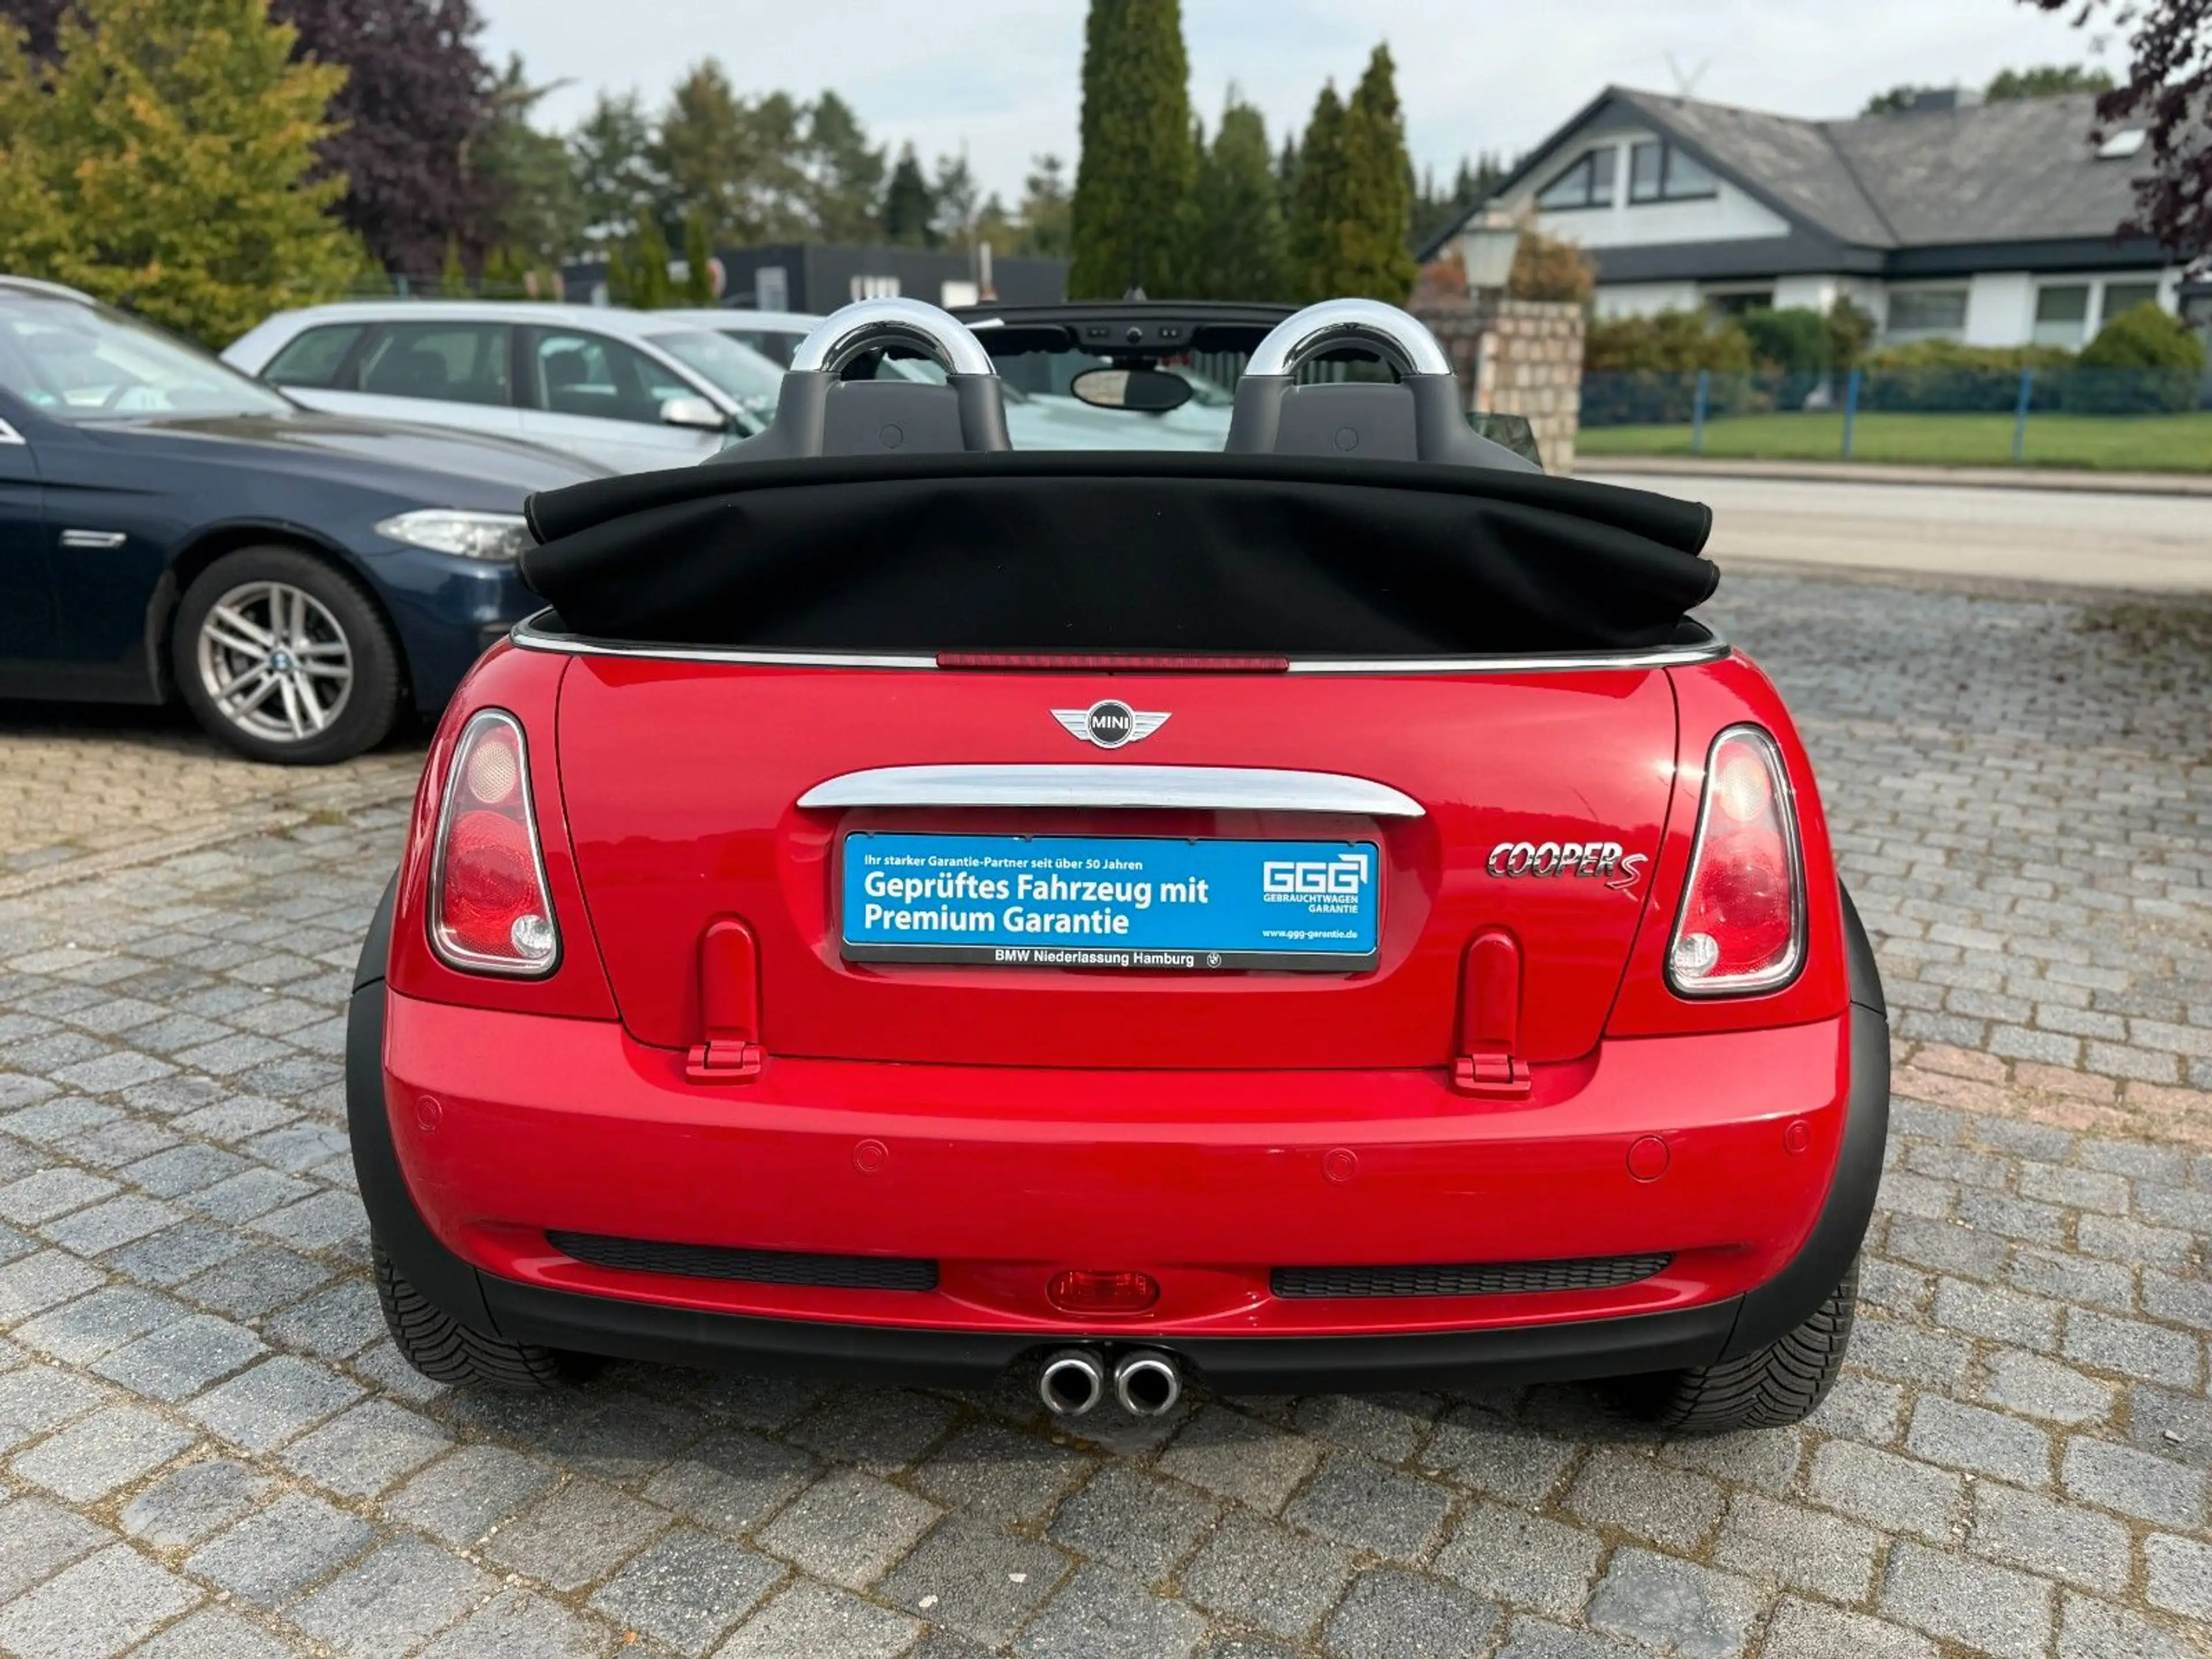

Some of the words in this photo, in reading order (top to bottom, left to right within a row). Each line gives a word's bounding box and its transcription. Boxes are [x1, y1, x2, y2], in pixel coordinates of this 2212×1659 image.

[1092, 715, 1128, 729] MINI
[865, 855, 881, 865] Ihr
[884, 855, 925, 866] starker
[929, 856, 1028, 869] Garantie-Partner
[1031, 858, 1052, 869] seit
[1056, 858, 1082, 869] über
[1086, 859, 1100, 869] 50
[1102, 859, 1143, 870] Jahren
[1488, 842, 1623, 878] COOPER
[1605, 853, 1649, 889] S
[1264, 862, 1359, 893] GGG
[865, 871, 1009, 904] Geprüftes
[1018, 873, 1152, 909] Fahrzeug
[1161, 877, 1209, 903] mit
[1263, 893, 1358, 903] GEBRAUCHTWAGEN
[1308, 904, 1358, 914] GARANTIE
[865, 904, 995, 931] Premium
[1003, 906, 1129, 934] Garantie
[1262, 929, 1358, 940] www.ggg-garantie.de
[995, 950, 1031, 961] BMW
[1034, 950, 1129, 967] Niederlassung
[1134, 953, 1194, 967] Hamburg
